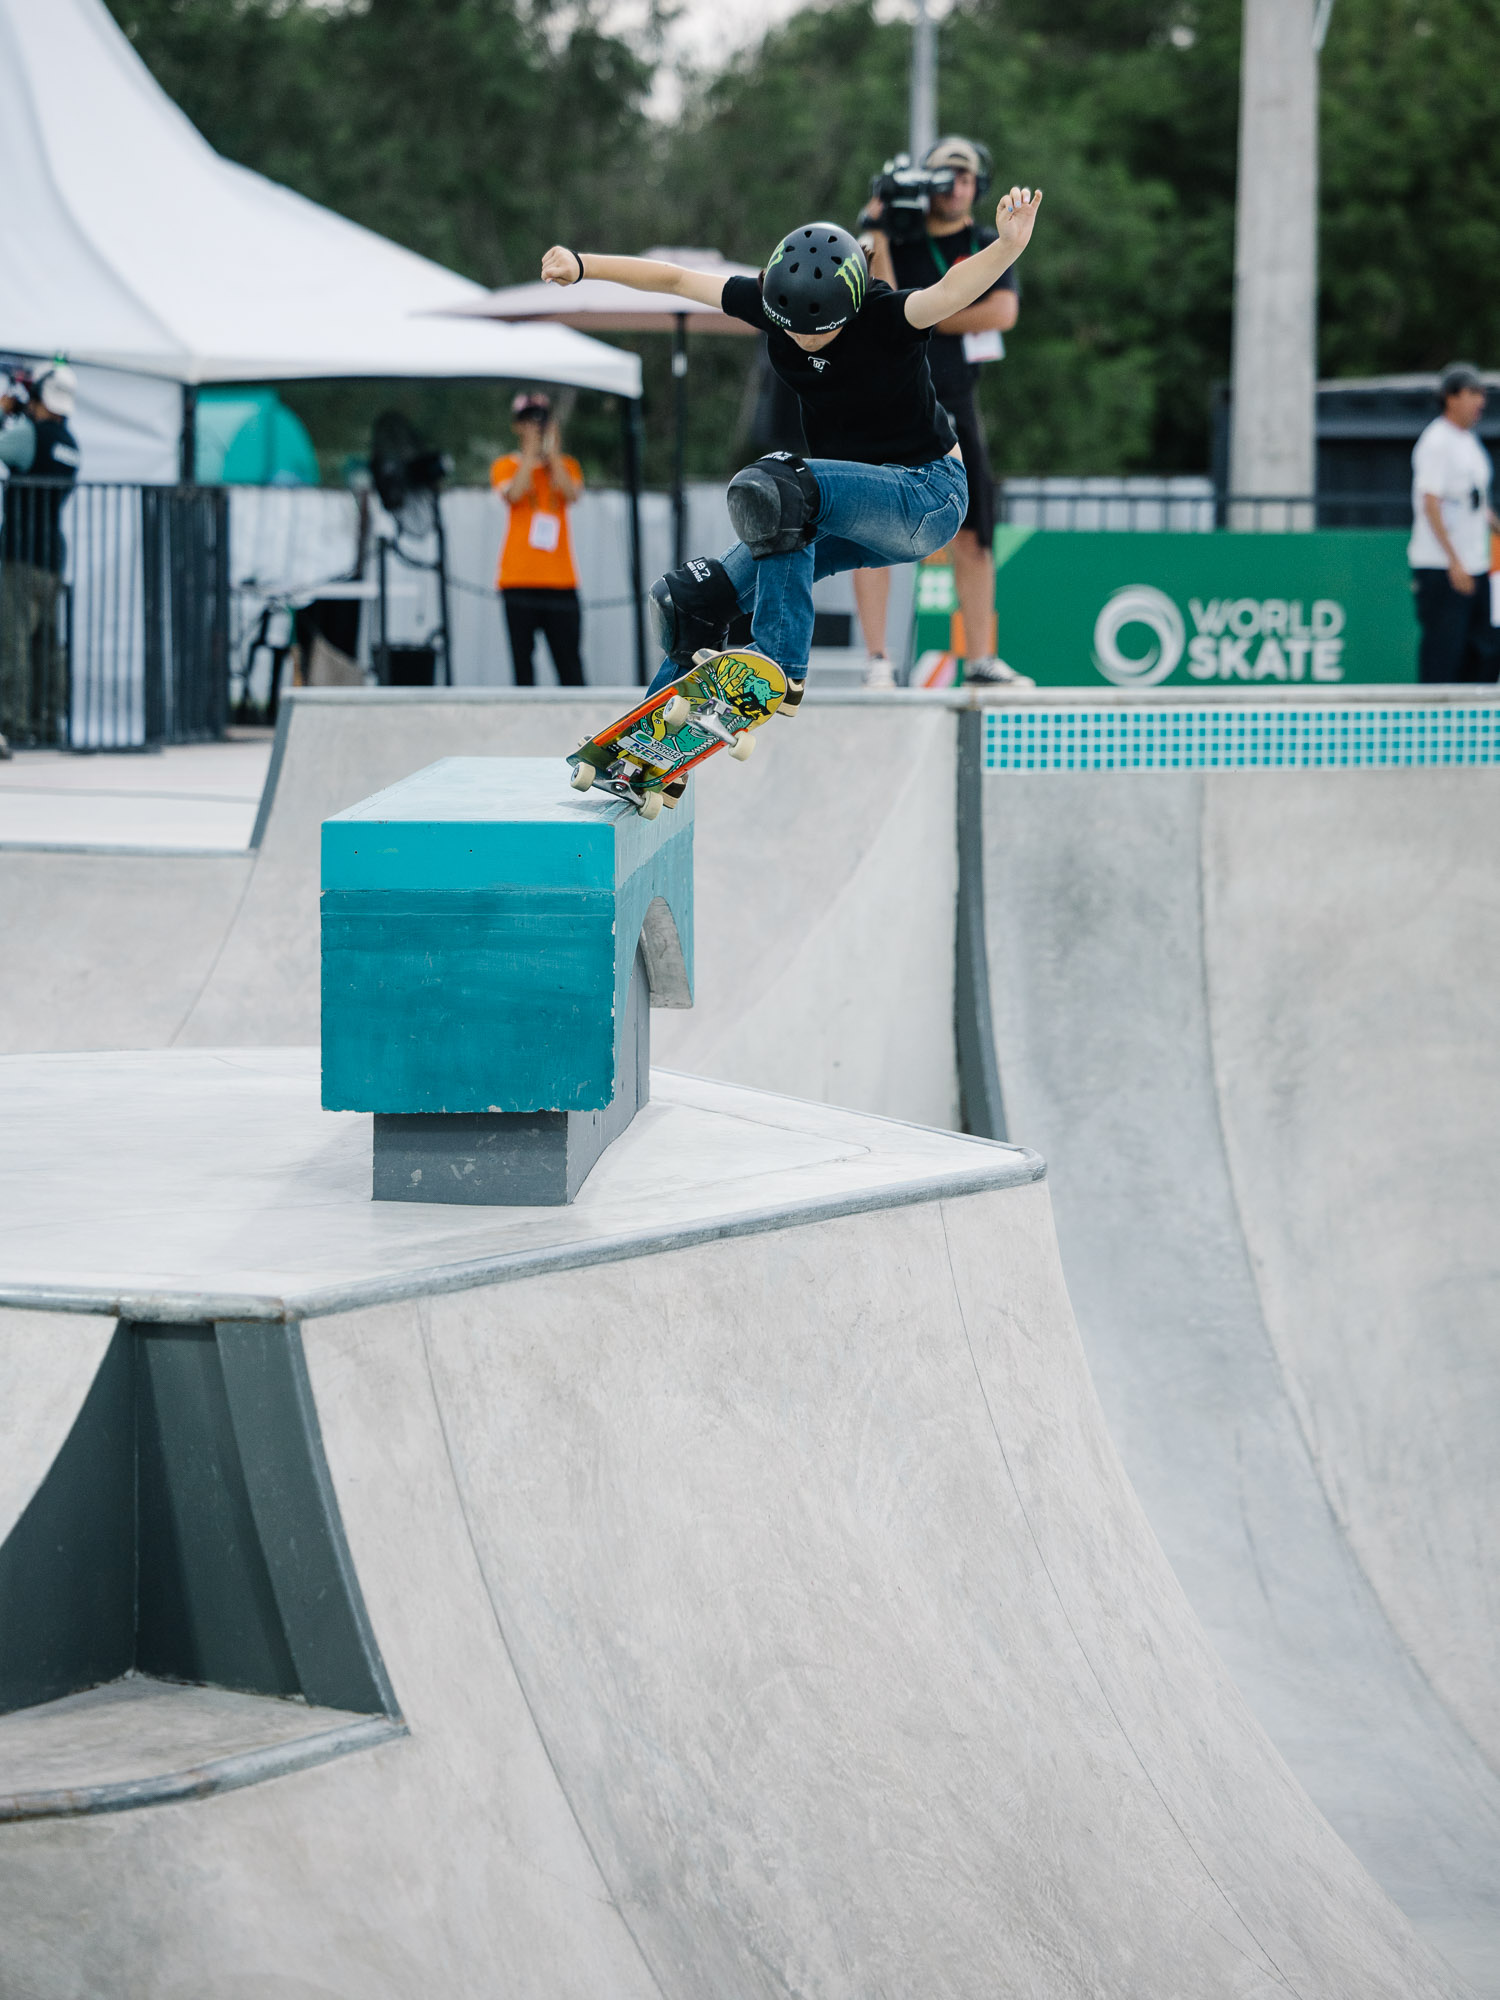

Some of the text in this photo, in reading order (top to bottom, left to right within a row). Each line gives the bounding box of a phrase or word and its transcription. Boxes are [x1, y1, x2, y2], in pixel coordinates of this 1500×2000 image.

[693, 559, 711, 577] 187
[1188, 598, 1346, 637] WORLD
[1187, 636, 1345, 681] SKATE
[651, 743, 678, 759] VISION
[653, 740, 681, 757] WORLD
